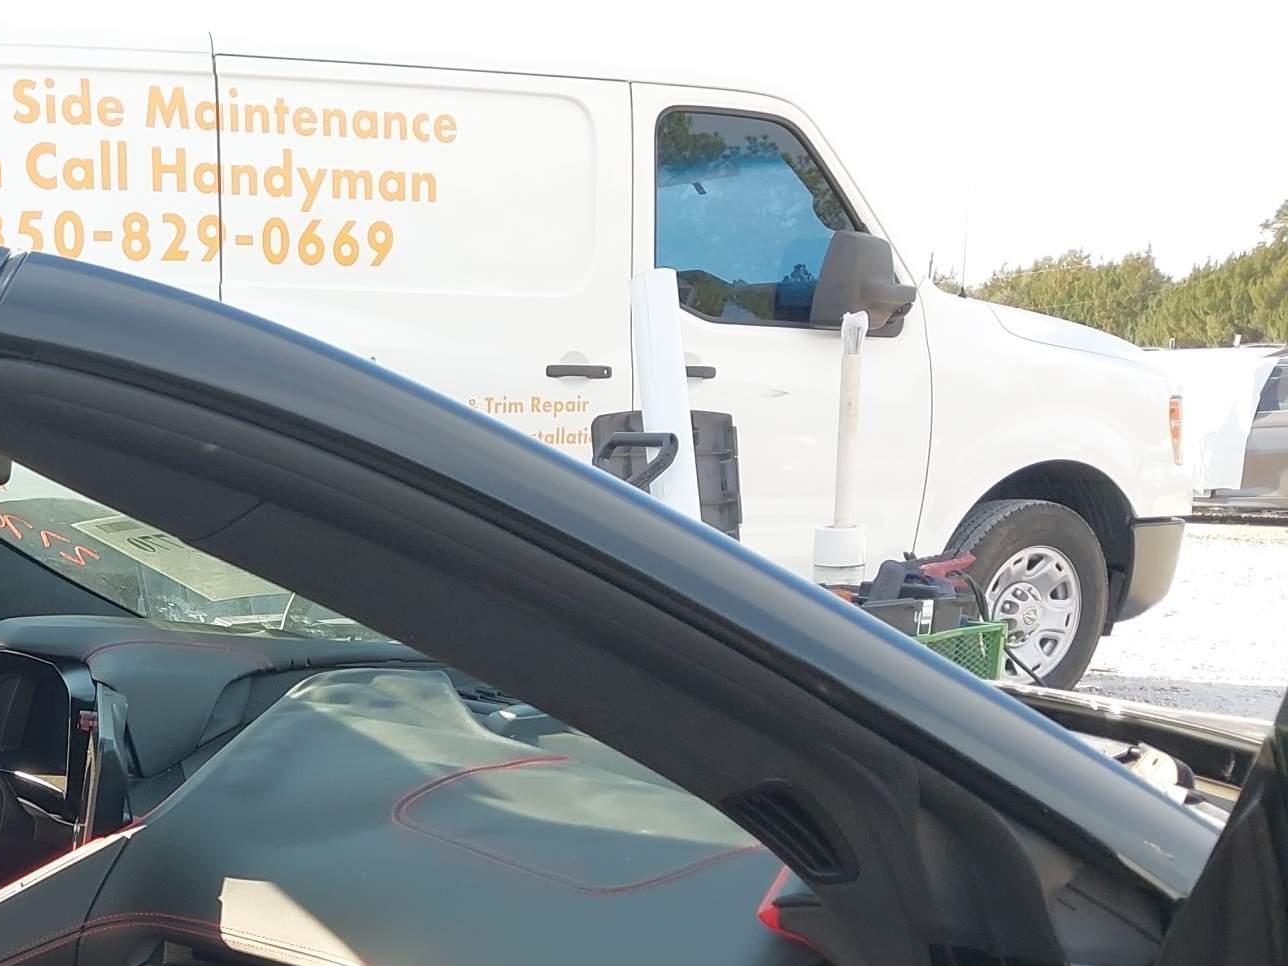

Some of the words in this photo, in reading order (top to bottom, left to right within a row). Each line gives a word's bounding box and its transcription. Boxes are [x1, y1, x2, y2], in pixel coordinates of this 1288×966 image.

[12, 78, 124, 127] Side
[146, 86, 458, 144] Maintenance
[25, 141, 128, 190] Call
[152, 146, 438, 212] Handyman
[484, 396, 524, 414] Trim
[530, 395, 590, 418] Repair
